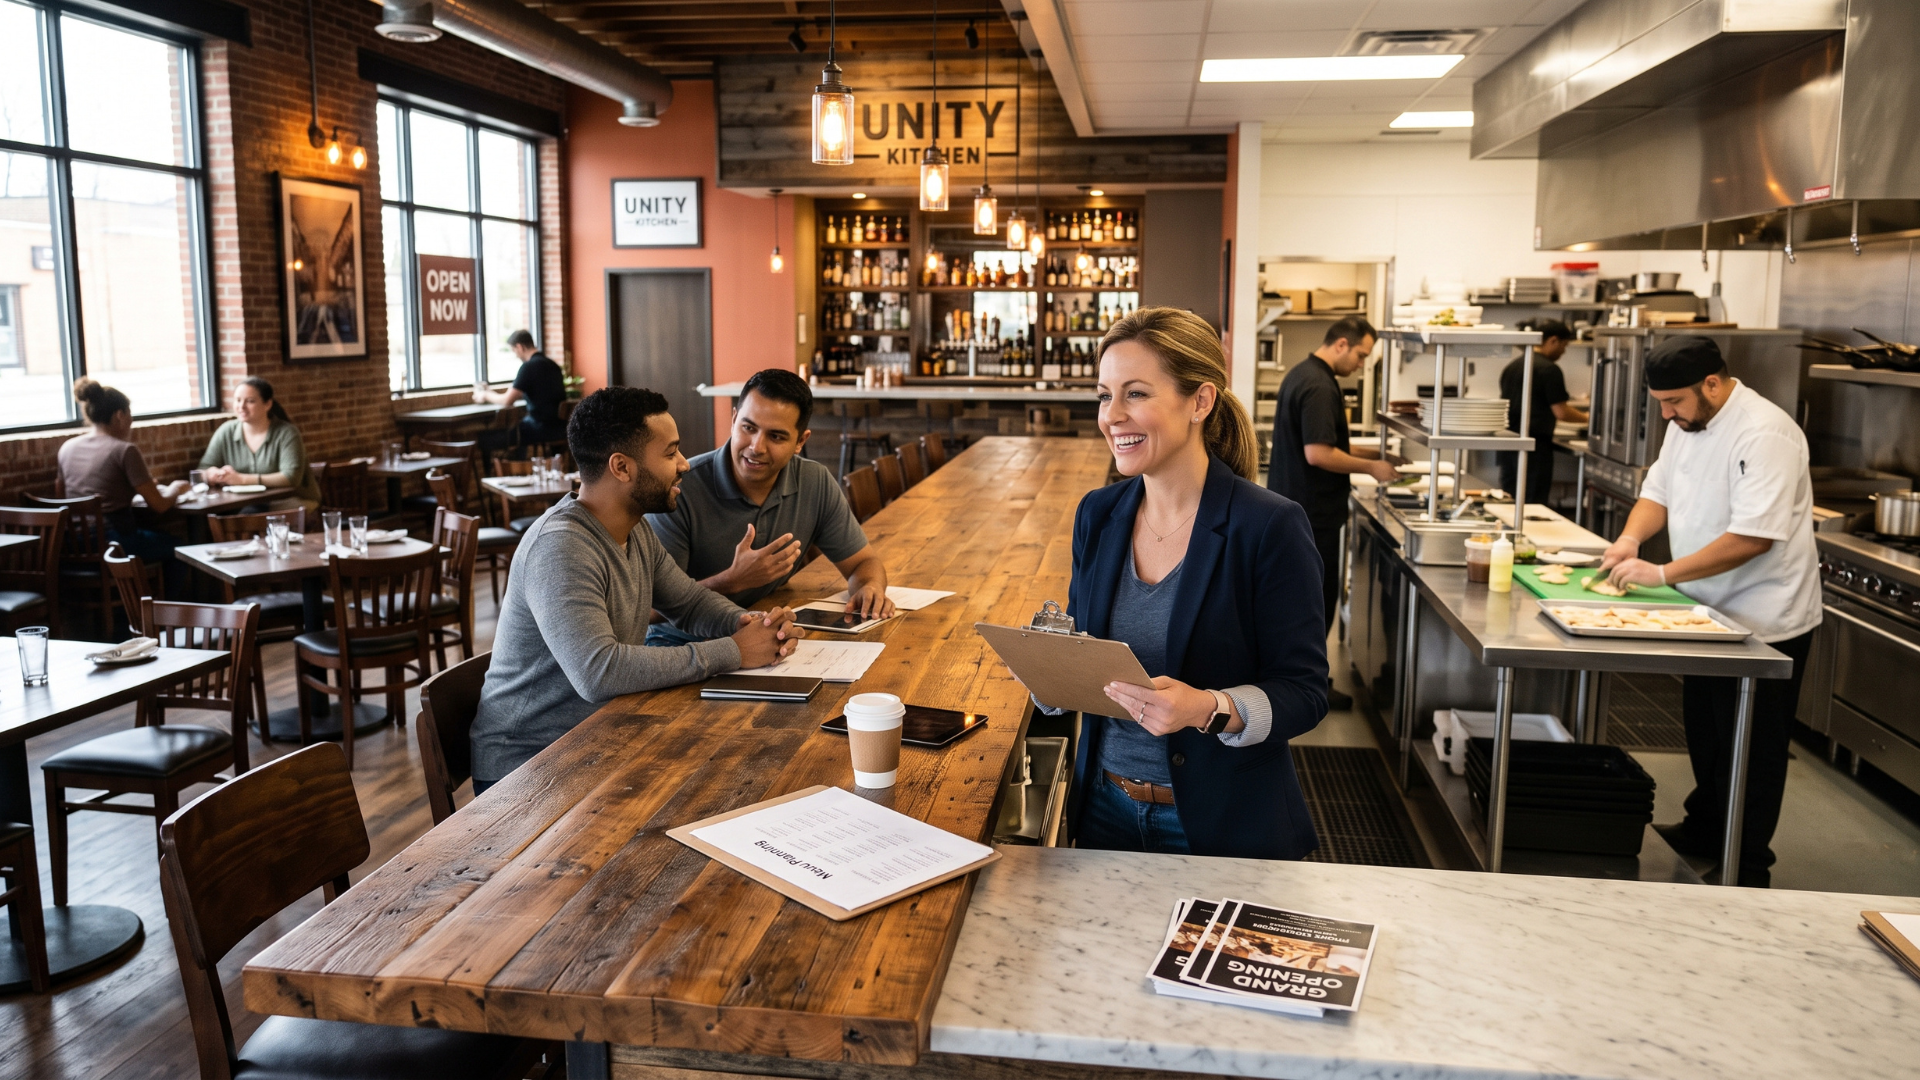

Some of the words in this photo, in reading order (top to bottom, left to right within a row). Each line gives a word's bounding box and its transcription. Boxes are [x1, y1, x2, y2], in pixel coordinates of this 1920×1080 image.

[862, 101, 1005, 140] UNITY
[625, 197, 686, 214] UNITY
[636, 218, 677, 226] KITCHEN
[426, 269, 471, 293] OPEN
[430, 298, 468, 321] NOW
[754, 840, 802, 866] Planning
[1227, 960, 1343, 989] OPENING
[1233, 975, 1327, 998] GRAND
